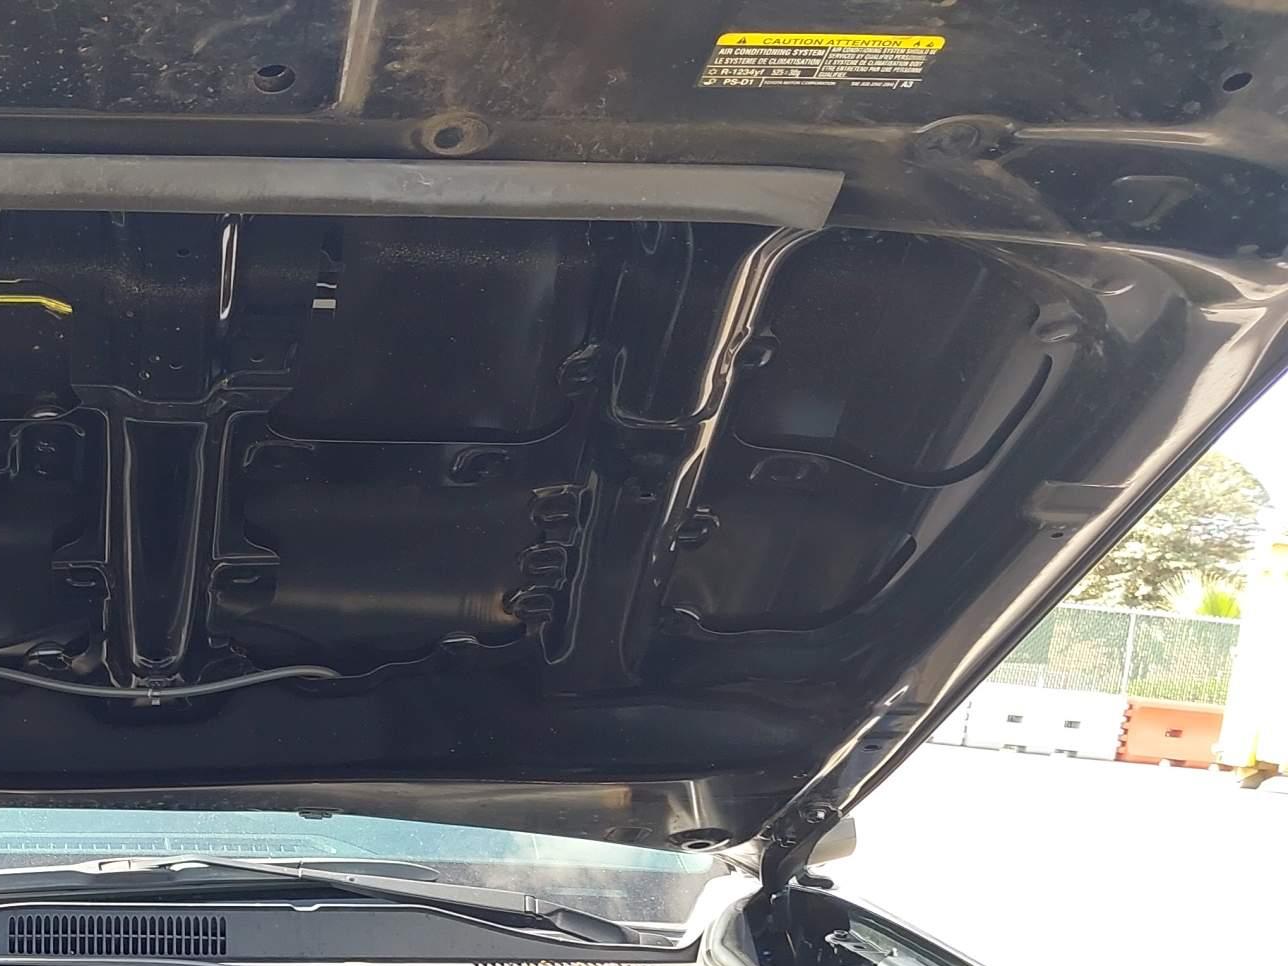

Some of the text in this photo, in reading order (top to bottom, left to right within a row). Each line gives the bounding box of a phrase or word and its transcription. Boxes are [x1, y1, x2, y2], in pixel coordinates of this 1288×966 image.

[762, 37, 903, 48] CAUTION ATTENTION
[733, 48, 793, 56] CONDITIONING
[792, 48, 826, 57] SYSTEM
[713, 57, 725, 65] LE
[757, 57, 770, 65] DE
[768, 57, 823, 66] CLIMATISATION
[720, 68, 765, 77] R-1234yf
